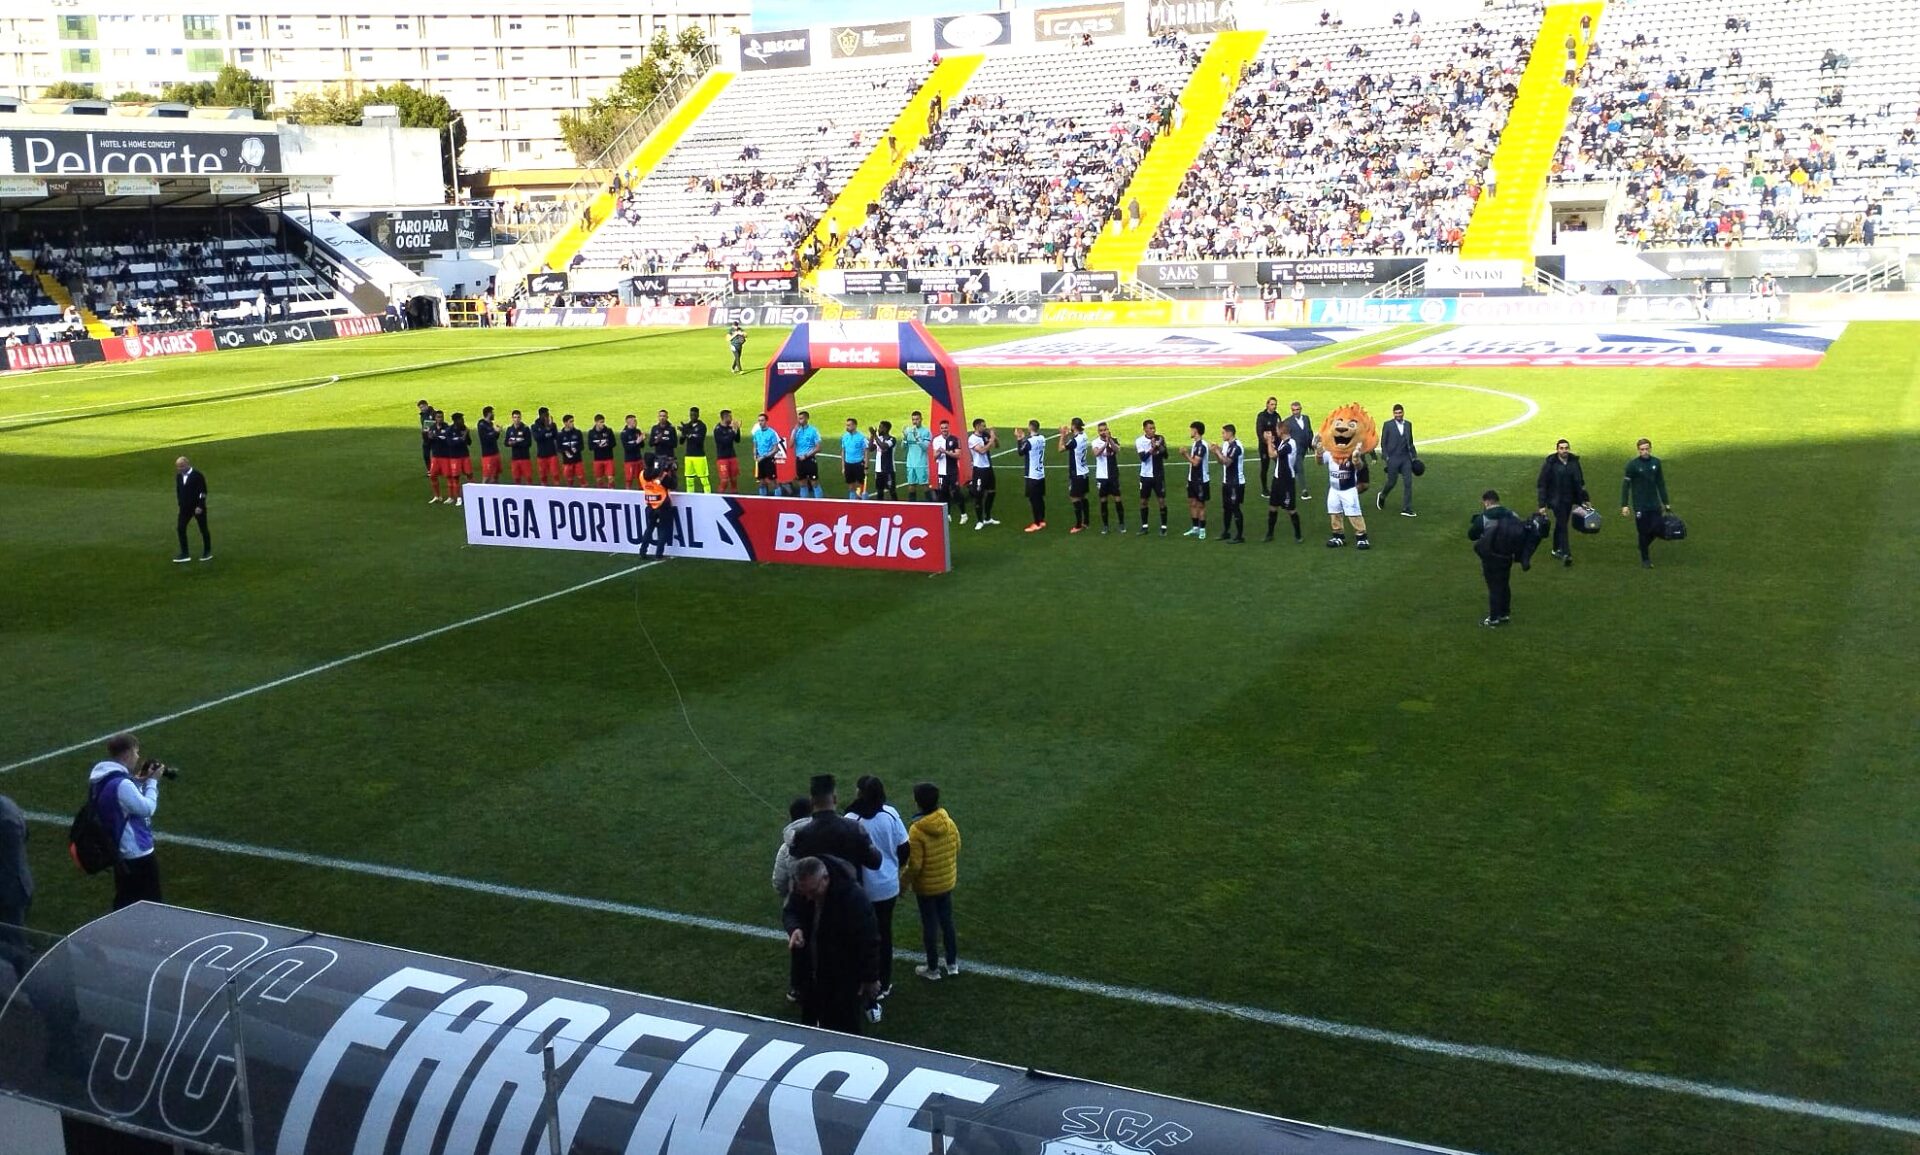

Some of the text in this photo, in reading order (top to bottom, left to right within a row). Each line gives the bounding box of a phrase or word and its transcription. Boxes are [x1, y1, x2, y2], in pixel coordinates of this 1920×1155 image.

[100, 140, 121, 148] HOTEL
[128, 140, 146, 148] HOME
[147, 140, 176, 148] CONCEPT
[25, 134, 222, 173] Pelcorte
[395, 219, 449, 234] FARO PARA
[396, 234, 432, 249] O GOLE
[1296, 262, 1375, 274] CONTREIRAS
[713, 308, 755, 324] MEO
[764, 307, 809, 324] MEO
[930, 305, 958, 323] NOS
[1008, 305, 1037, 323] NOS
[284, 325, 308, 340] NOS
[334, 317, 382, 337] PLACARD
[142, 332, 198, 357] SAGRES
[219, 330, 246, 347] NOS
[253, 328, 278, 344] NOS
[7, 343, 75, 368] PLACARD
[828, 347, 880, 364] Betclic
[478, 497, 703, 549] LIGA PORTUAL
[775, 512, 928, 560] Betclic
[87, 930, 338, 1135] SC
[1061, 1105, 1193, 1149] SCF
